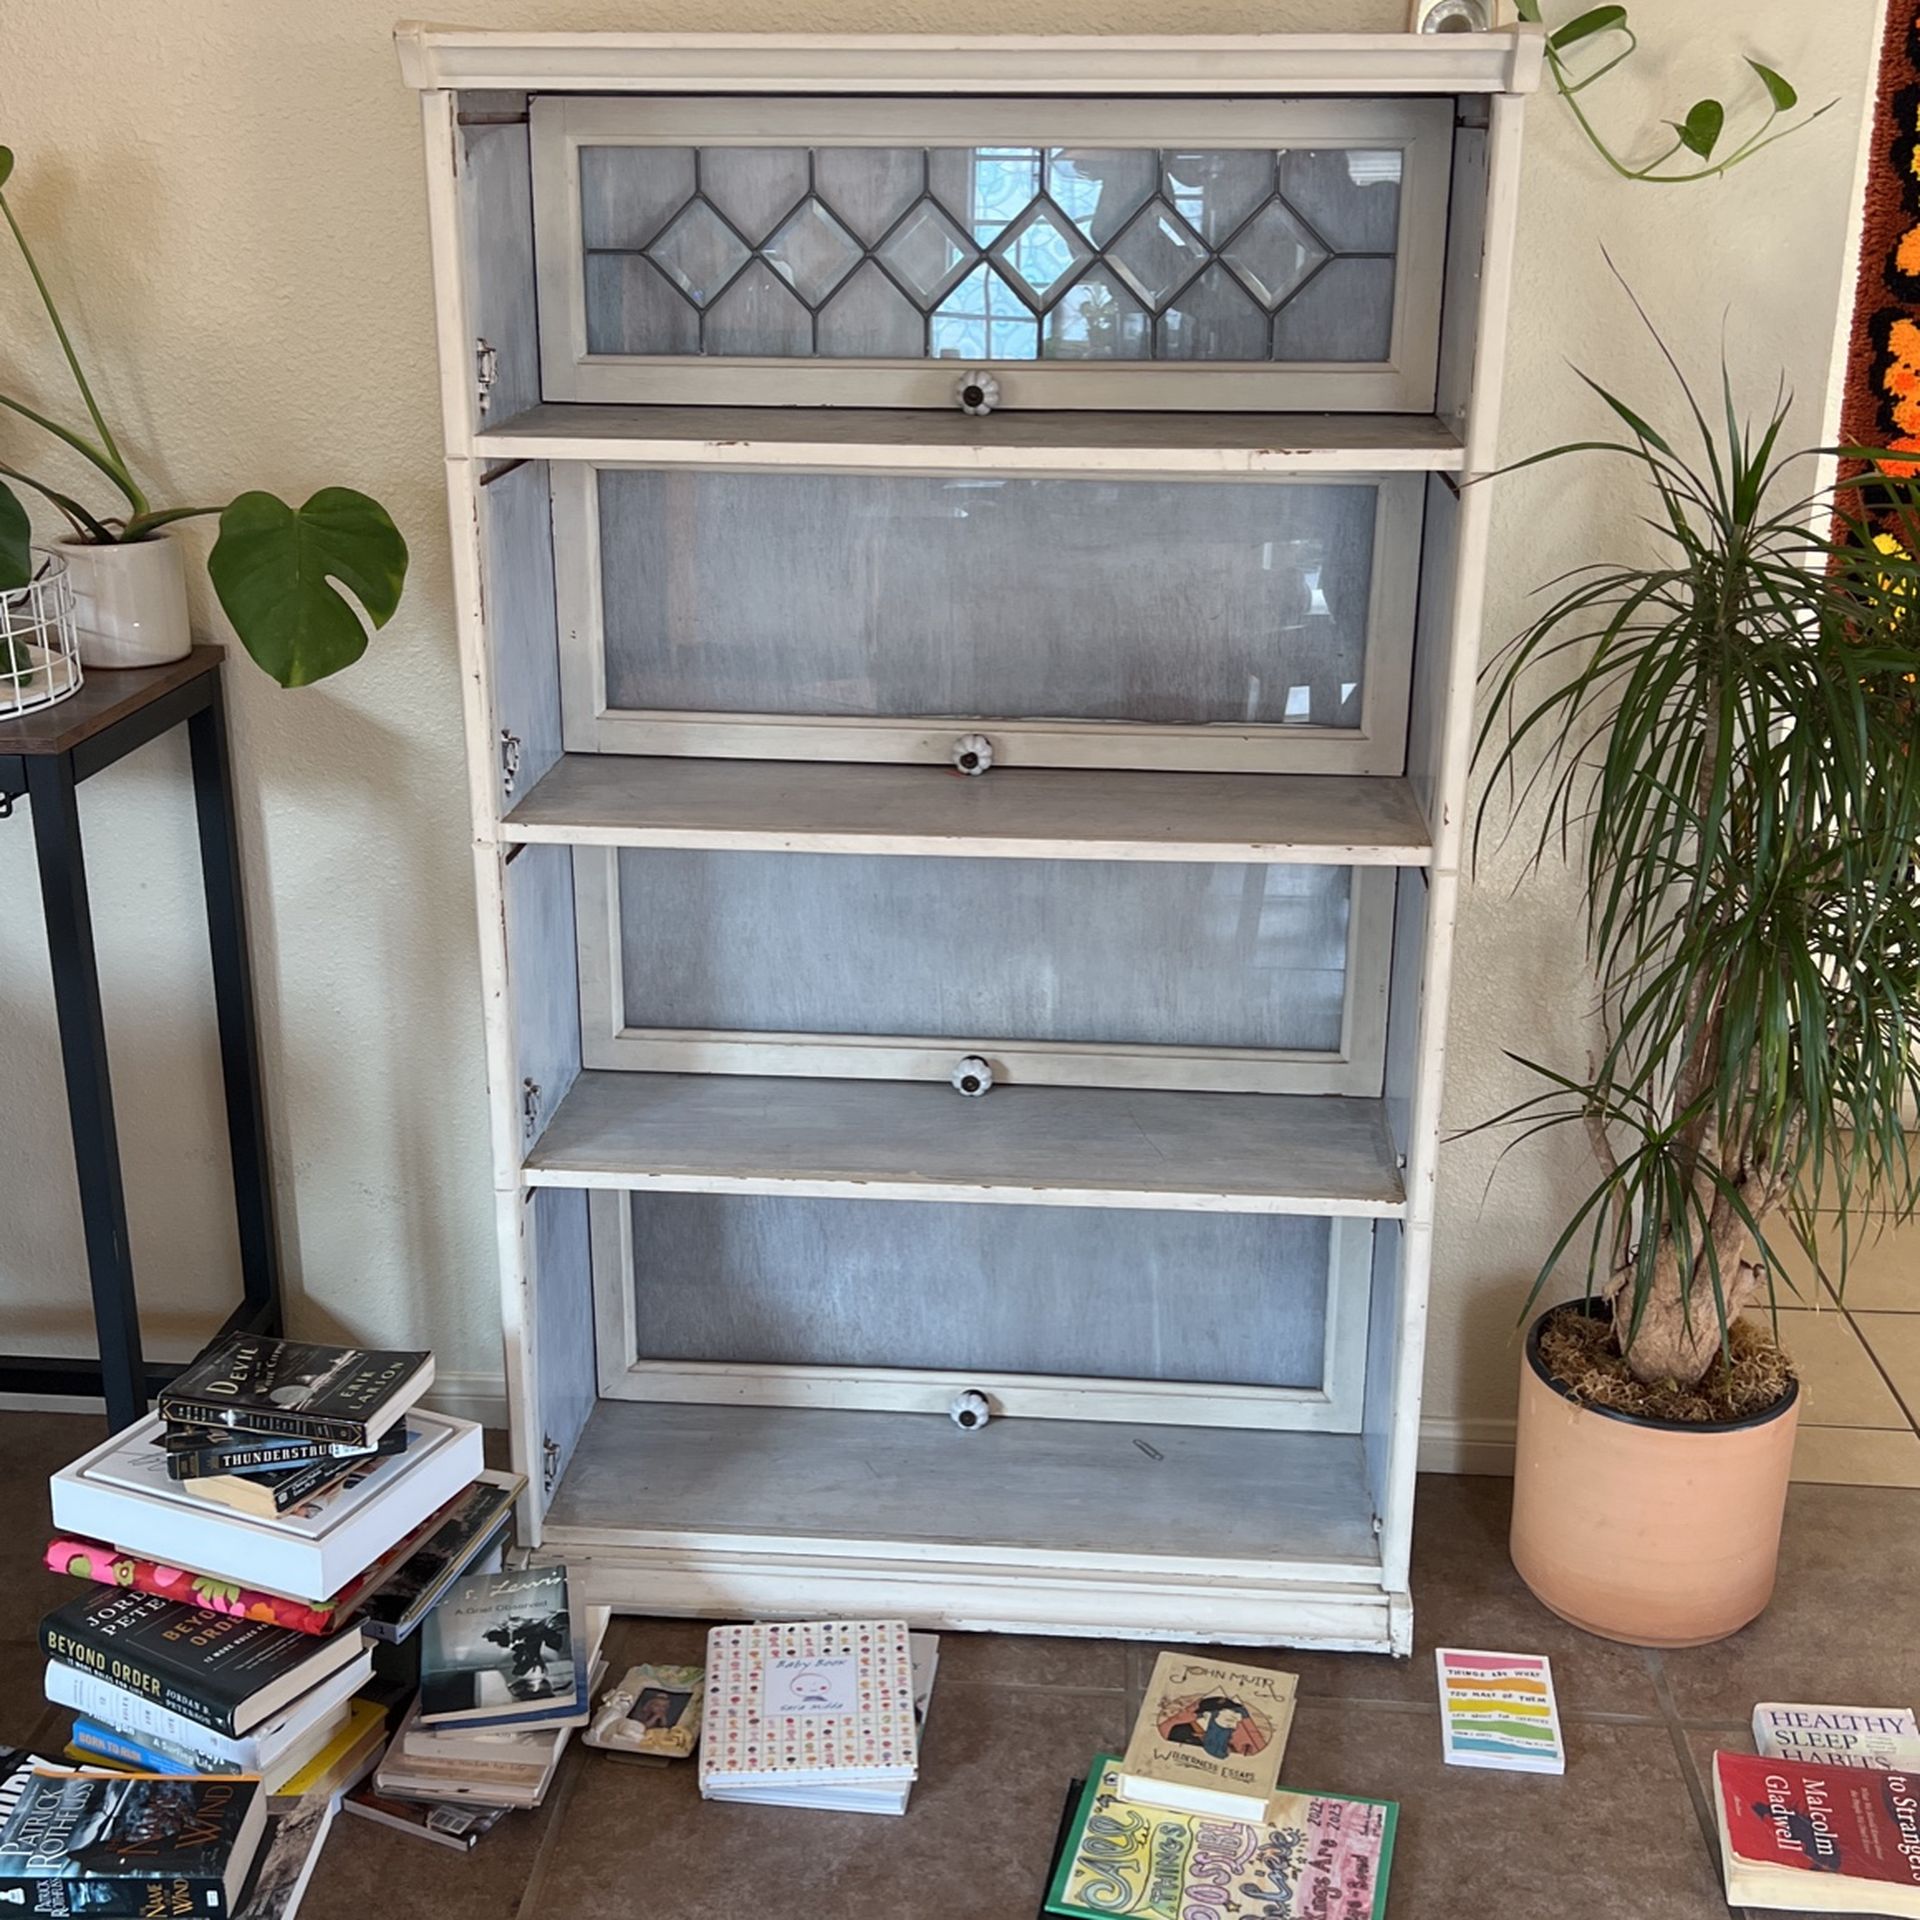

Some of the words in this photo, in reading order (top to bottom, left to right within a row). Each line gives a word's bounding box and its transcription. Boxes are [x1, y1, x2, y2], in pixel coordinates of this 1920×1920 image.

[205, 1348, 259, 1394] DEVIL
[48, 1631, 106, 1671] BEYOND
[112, 1660, 161, 1697] ORDER
[1169, 1665, 1226, 1684] JOHN
[1229, 1671, 1286, 1703] MUIR
[1770, 1711, 1904, 1735] HEALTHY
[1775, 1731, 1858, 1750] SLEEP
[1887, 1775, 1908, 1793] to
[0, 1788, 65, 1856] PATRICK
[26, 1783, 95, 1870] ROTHFUSS
[175, 1785, 234, 1849] WIND
[1327, 1803, 1343, 1831] 2023
[1765, 1775, 1803, 1851] Gladwell
[1802, 1778, 1839, 1856] Malcolm
[1151, 1823, 1187, 1904] THINGS
[1308, 1839, 1338, 1874] Are
[172, 1878, 193, 1915] WIND
